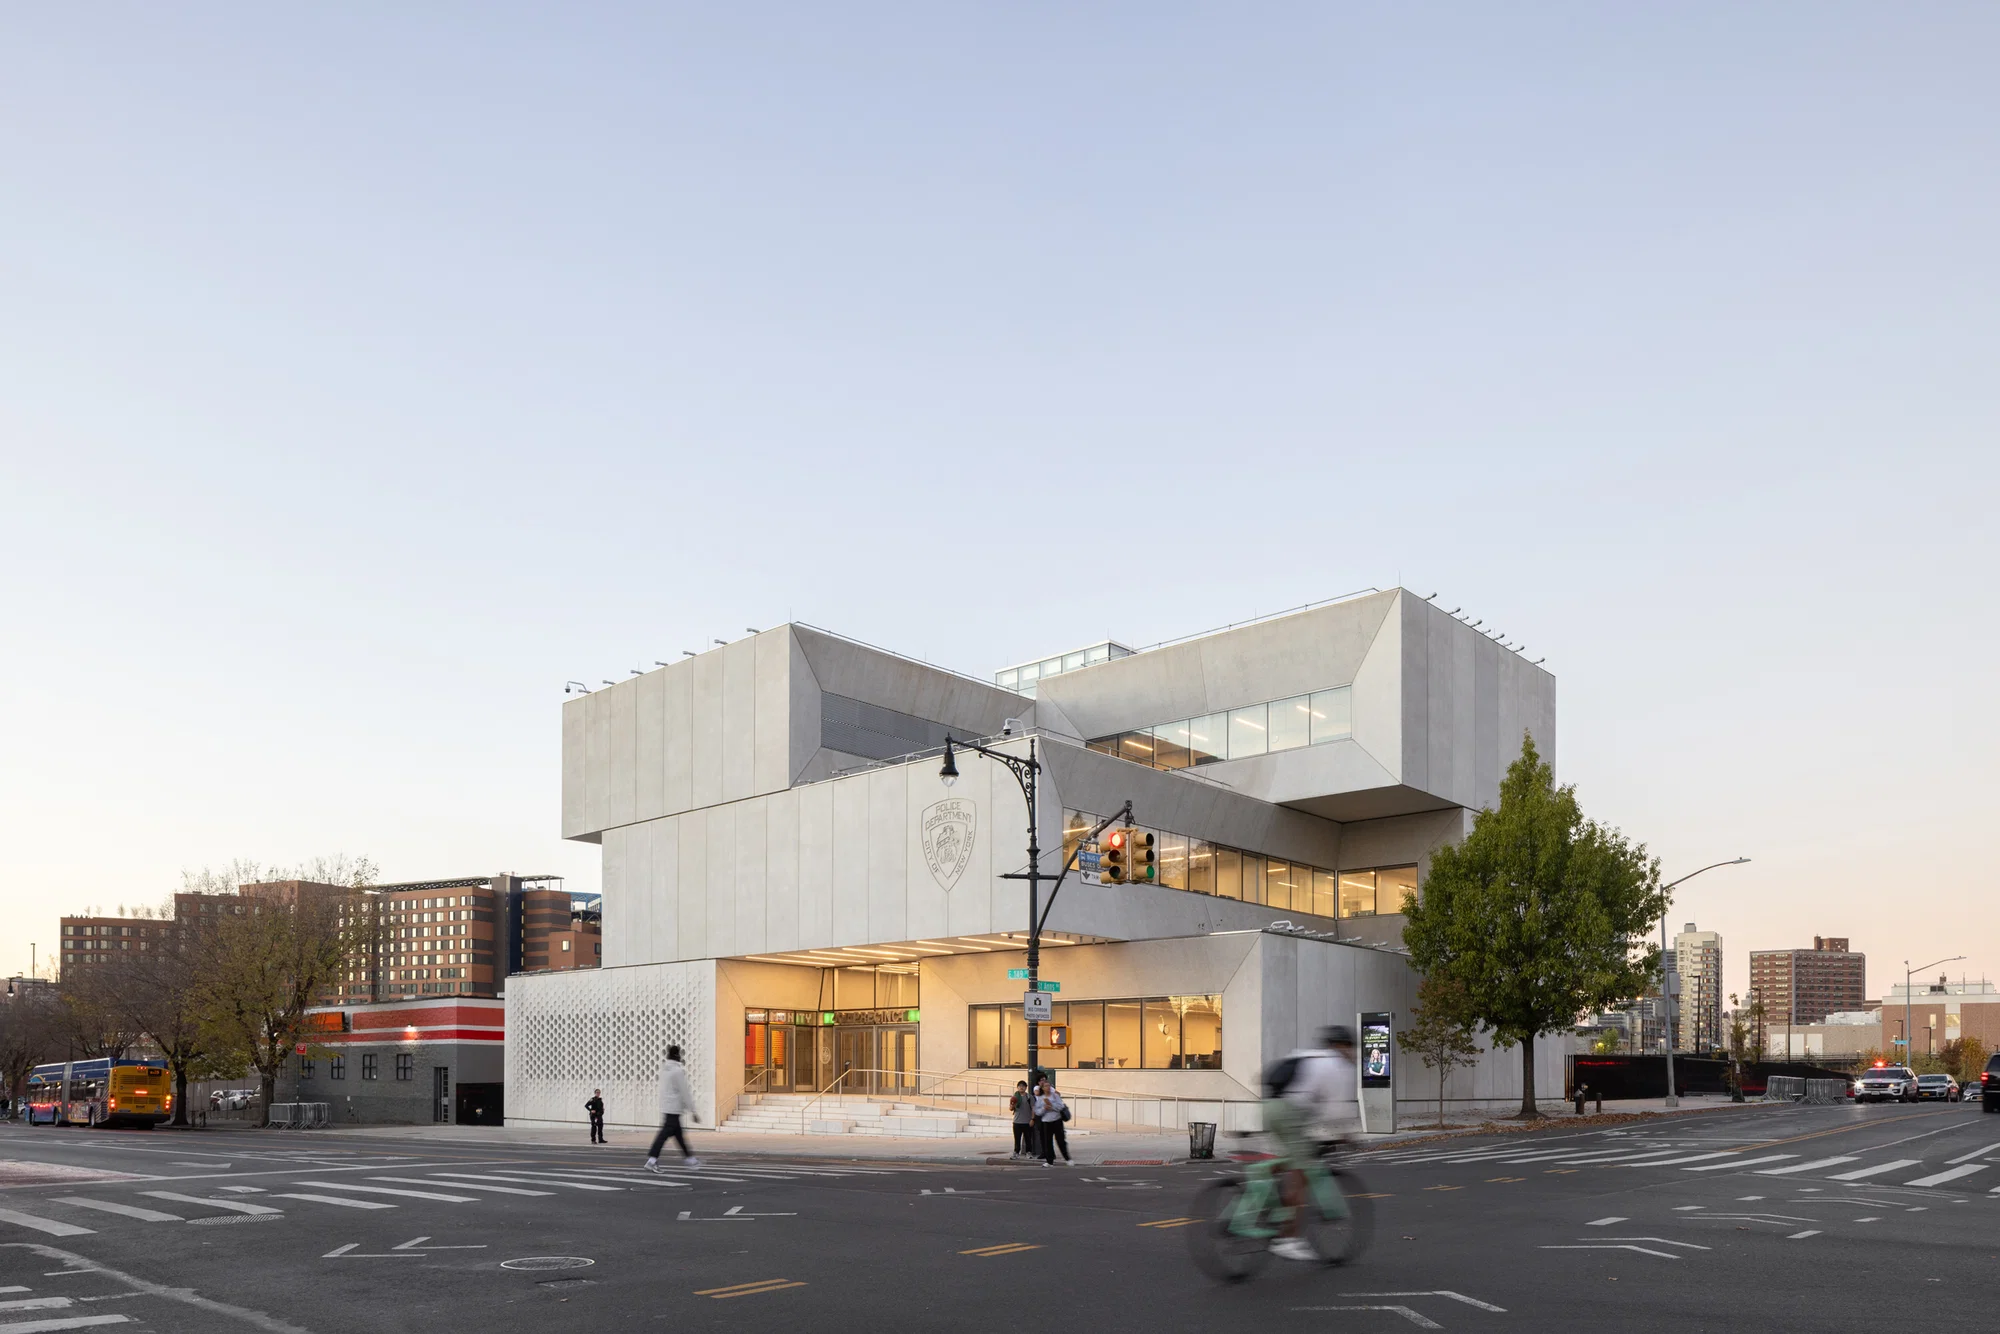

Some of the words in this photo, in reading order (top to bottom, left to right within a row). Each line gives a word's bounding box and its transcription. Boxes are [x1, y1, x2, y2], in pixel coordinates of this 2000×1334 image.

[936, 802, 961, 814] POLICE
[925, 811, 972, 831] DEPARTMENT
[925, 840, 934, 861] CITY
[931, 863, 940, 873] OF
[955, 855, 966, 875] NEW
[964, 830, 974, 852] YORK
[1008, 970, 1012, 979] E
[1013, 970, 1024, 978] 149
[1043, 982, 1055, 991] Anns
